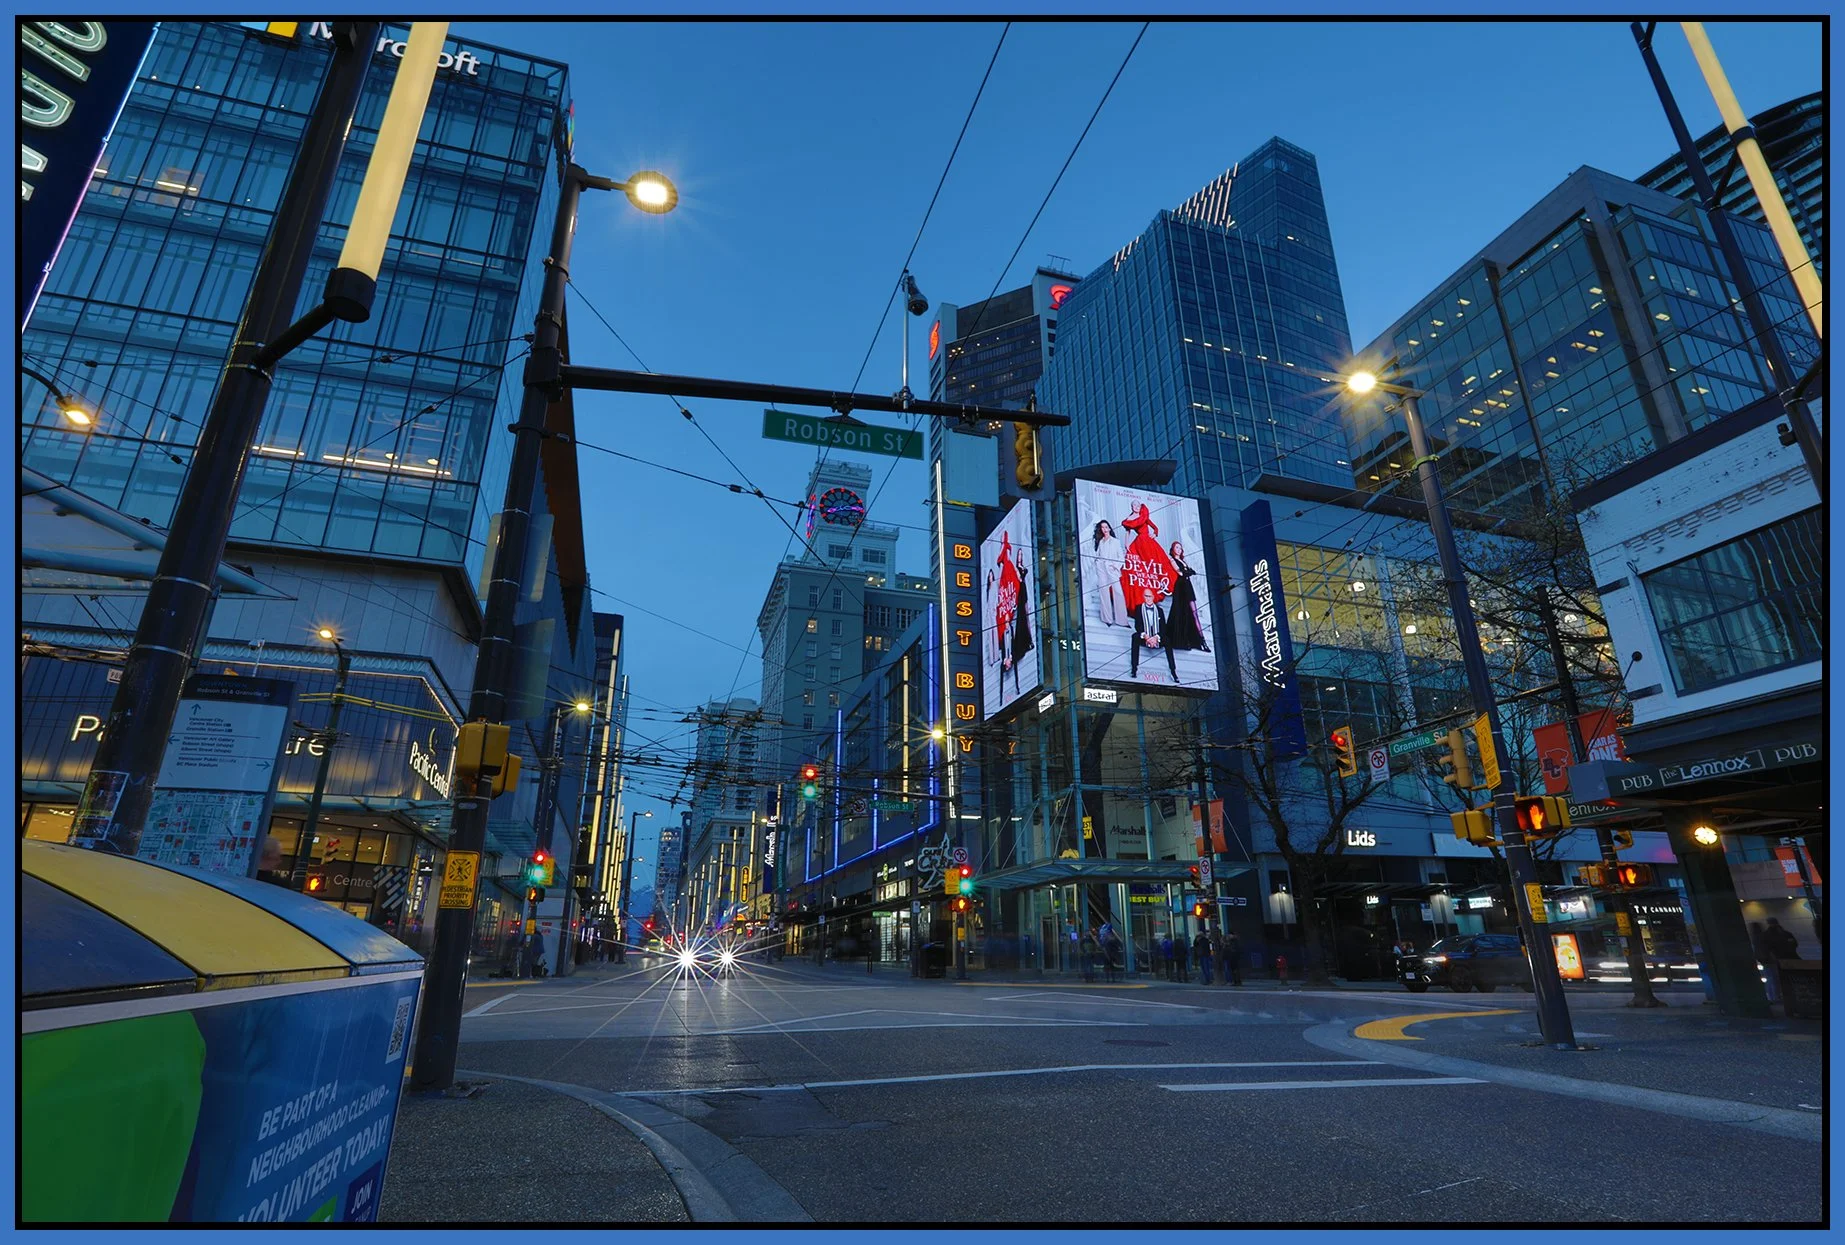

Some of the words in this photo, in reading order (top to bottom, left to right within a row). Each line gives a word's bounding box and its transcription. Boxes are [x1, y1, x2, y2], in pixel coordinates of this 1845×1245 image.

[784, 418, 872, 448] Robson
[883, 433, 904, 451] St
[1122, 558, 1168, 576] DEVIL
[1135, 571, 1159, 580] WEARS
[954, 544, 973, 647] BEST
[1249, 558, 1286, 690] Marshalls
[1144, 674, 1160, 682] MAY
[955, 672, 976, 753] BUY
[1087, 691, 1115, 701] astral
[1393, 736, 1430, 753] Granville
[1620, 774, 1653, 791] PUB
[1663, 769, 1678, 780] the
[1679, 756, 1752, 781] Lennox
[1774, 743, 1817, 763] PUB
[1347, 829, 1377, 847] Lids
[333, 873, 373, 888] Centre
[1148, 895, 1166, 903] BUY
[257, 1105, 282, 1141] BE
[281, 1090, 316, 1130] PART
[315, 1082, 332, 1112] OF
[329, 1079, 338, 1102] A
[246, 1104, 349, 1188] NEIGHBOURHOOD
[343, 1114, 390, 1173] TODAY!
[351, 1179, 373, 1214] JOIN
